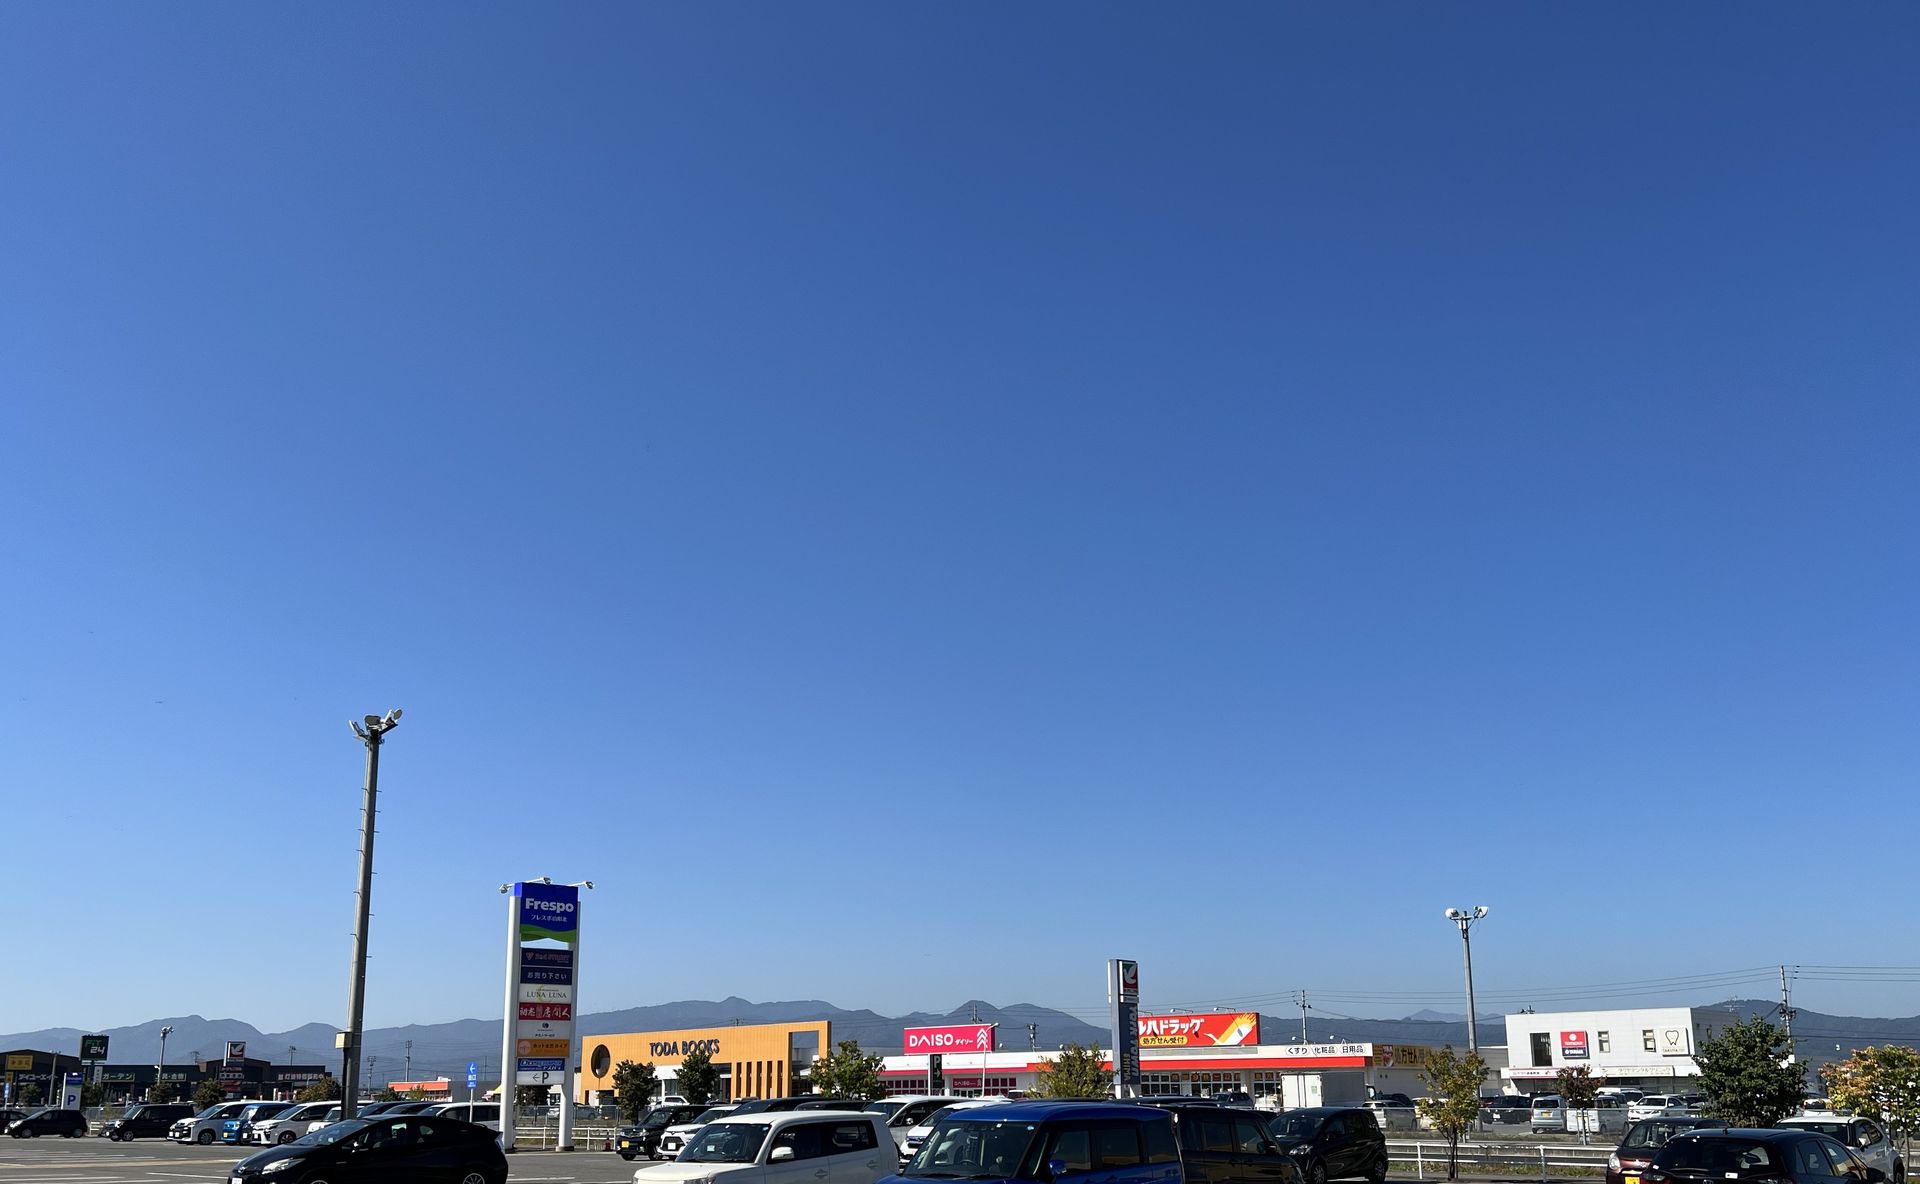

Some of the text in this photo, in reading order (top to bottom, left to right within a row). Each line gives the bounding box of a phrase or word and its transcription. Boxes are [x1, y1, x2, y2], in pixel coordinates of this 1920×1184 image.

[525, 897, 574, 914] Frespo
[526, 991, 546, 999] LUNA
[909, 1033, 954, 1048] DAISO
[1142, 1036, 1185, 1045] 処方せん受付
[90, 1046, 105, 1055] 24
[649, 1038, 720, 1057] TODA BOOKS
[1287, 1045, 1364, 1055] くすり 化粧品 日用品
[934, 1056, 941, 1068] P
[542, 1071, 550, 1084] P
[67, 1094, 76, 1106] P
